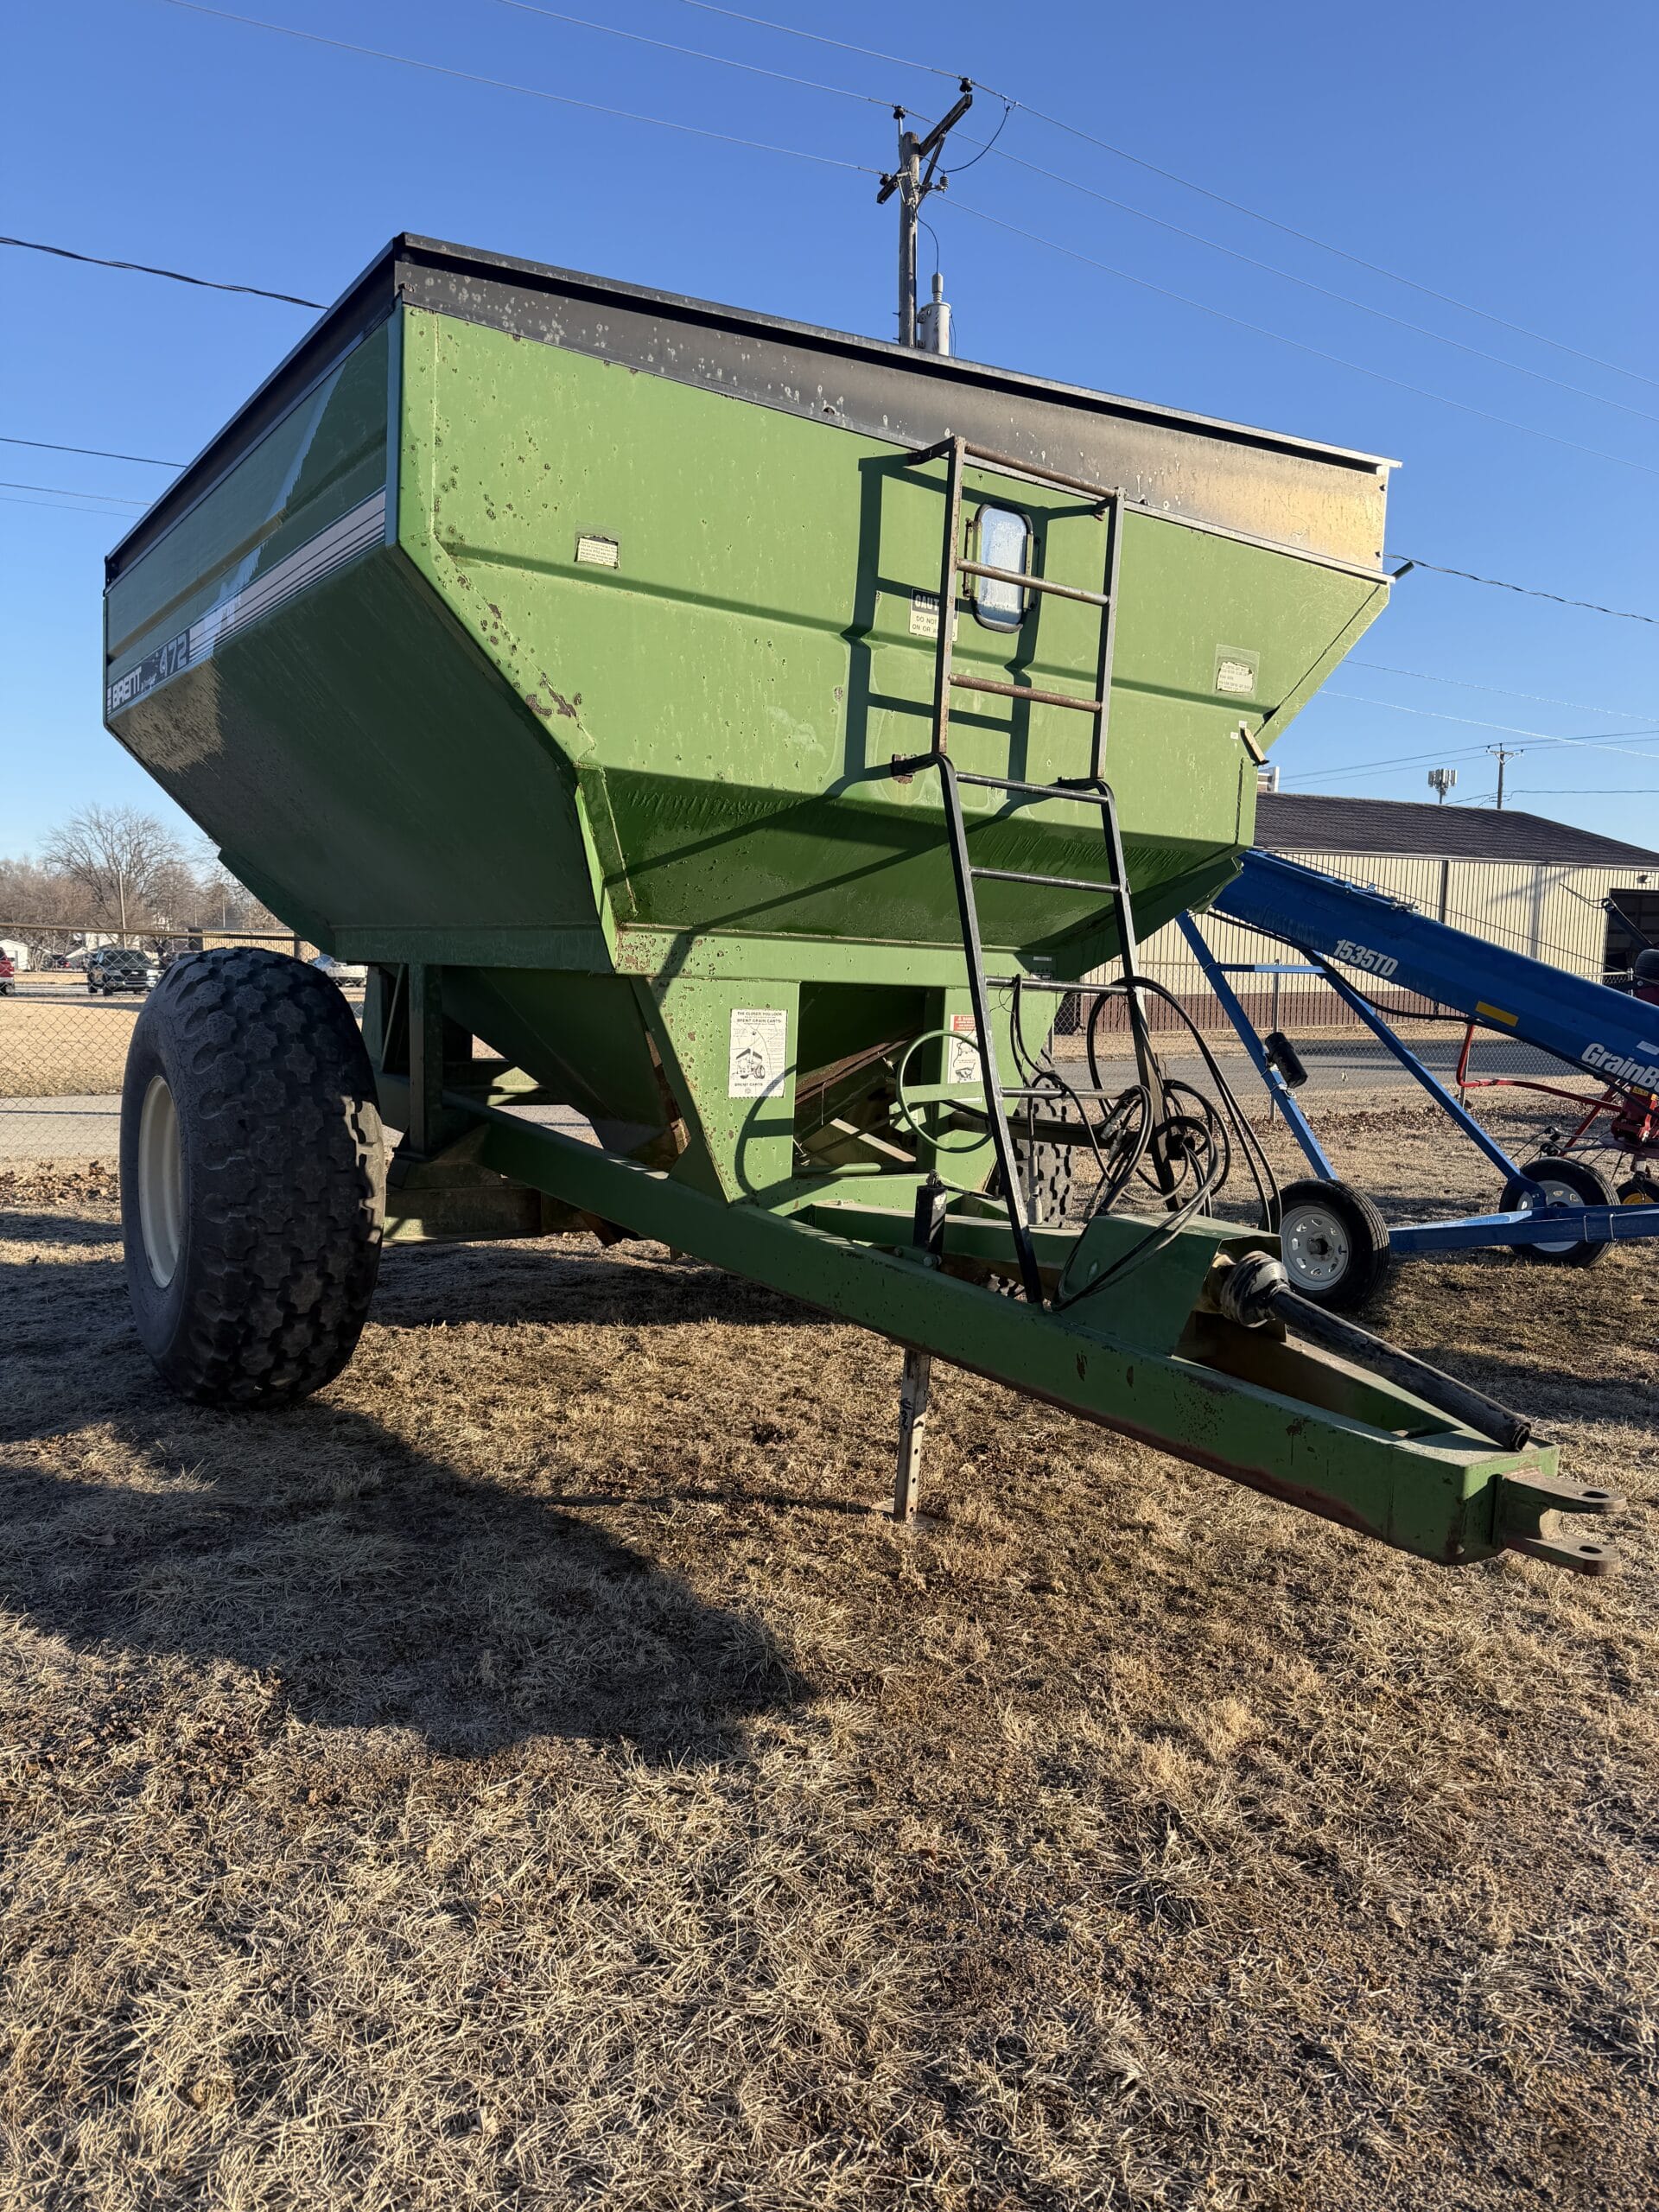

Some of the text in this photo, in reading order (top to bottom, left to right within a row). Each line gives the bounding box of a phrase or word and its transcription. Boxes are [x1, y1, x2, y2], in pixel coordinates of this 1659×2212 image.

[915, 594, 940, 612] CAUT
[159, 632, 188, 677] 472
[112, 665, 143, 709] BRENT
[1333, 938, 1399, 976] 1535TD
